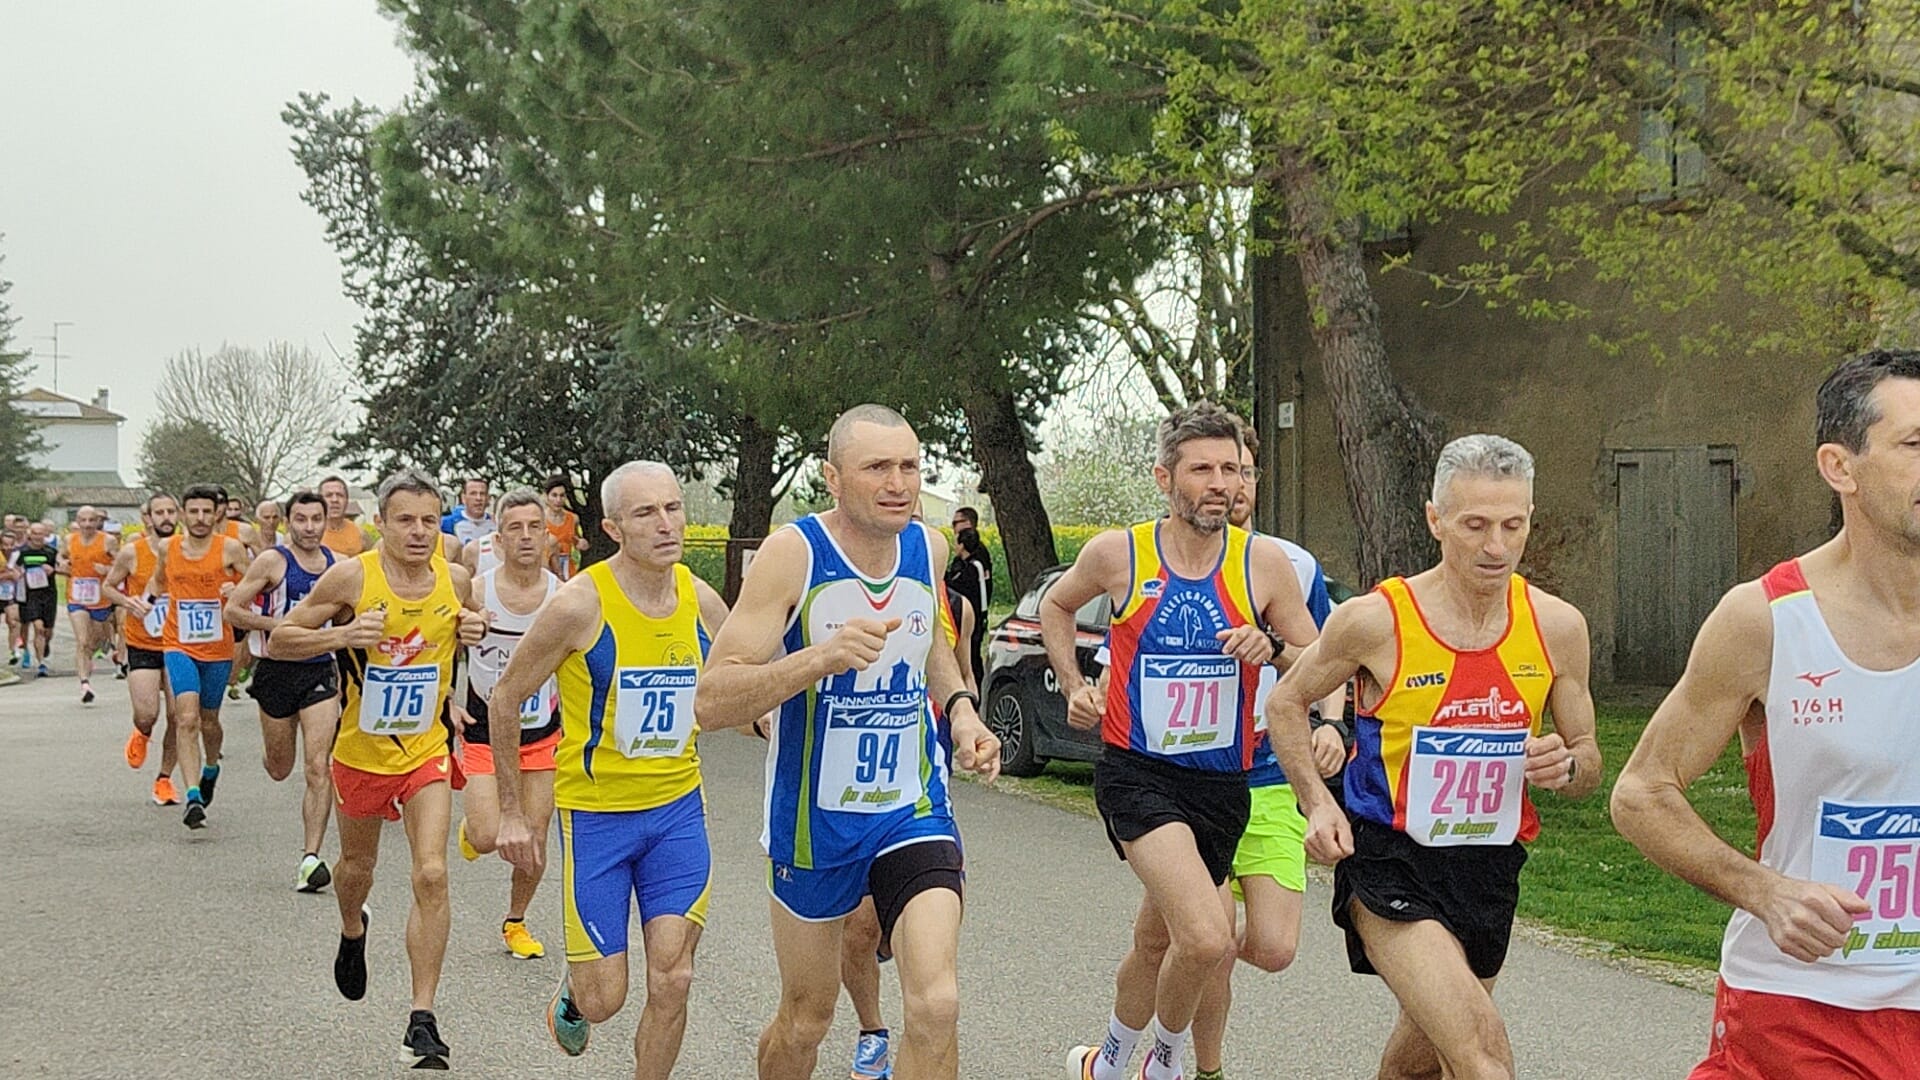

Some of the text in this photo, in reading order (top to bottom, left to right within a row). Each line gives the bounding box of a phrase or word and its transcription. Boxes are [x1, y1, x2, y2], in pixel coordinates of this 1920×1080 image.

[187, 611, 214, 631] 152
[382, 685, 425, 718] 175
[640, 691, 676, 734] 25
[823, 694, 886, 705] RUNNING
[1167, 681, 1219, 728] 271
[1792, 698, 1842, 715] 1/6 H
[1793, 715, 1844, 727] sport
[855, 732, 900, 783] 94
[1430, 760, 1507, 814] 243
